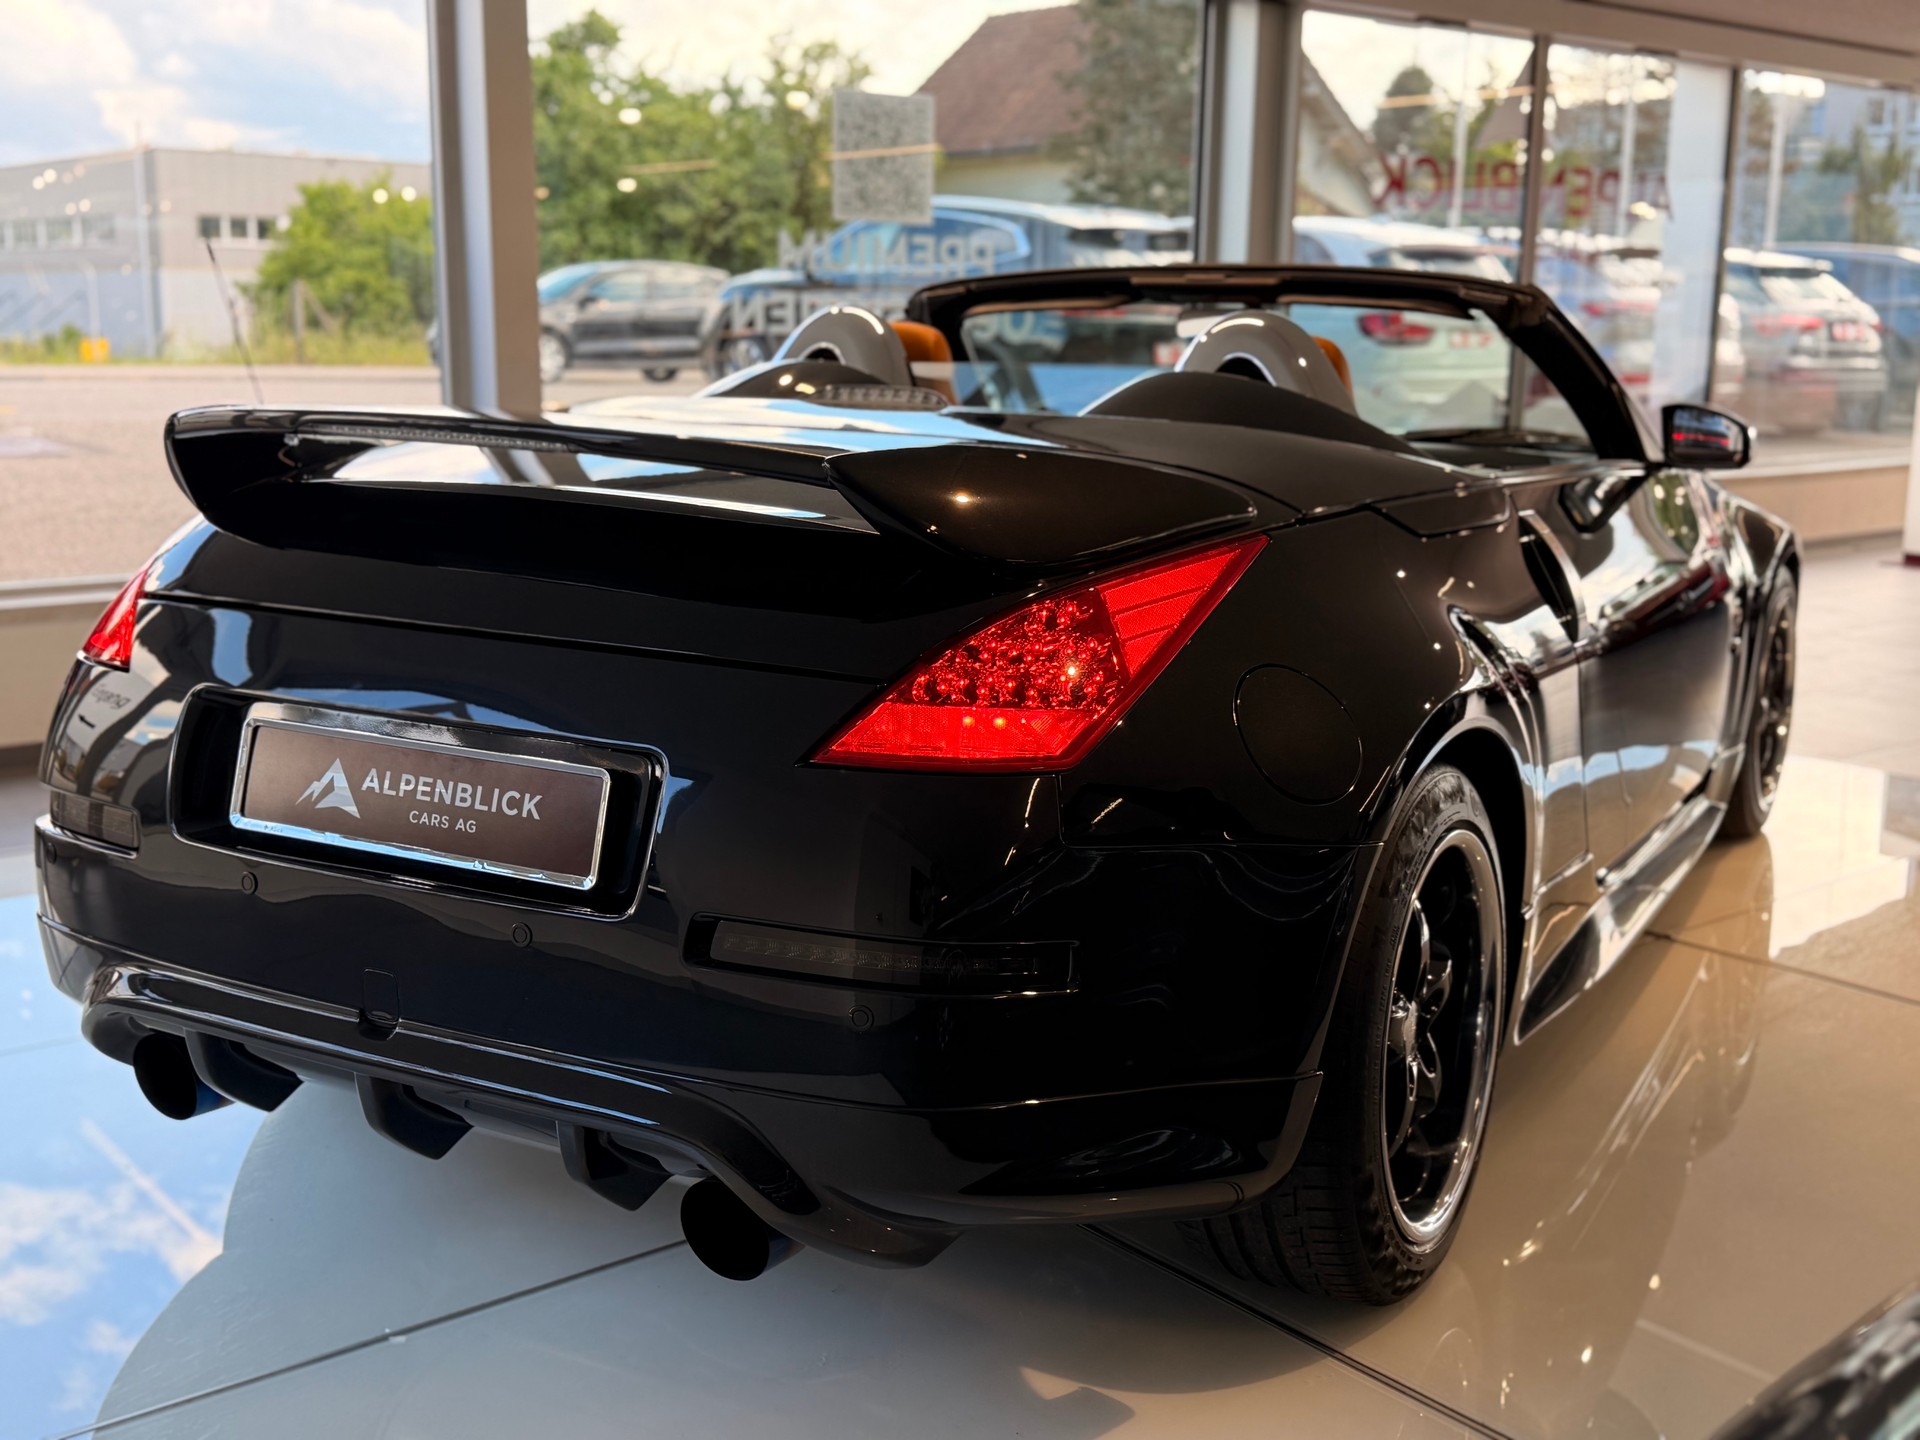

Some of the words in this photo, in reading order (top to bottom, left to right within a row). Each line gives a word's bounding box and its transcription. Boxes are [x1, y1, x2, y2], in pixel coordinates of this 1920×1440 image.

[361, 768, 543, 820] ALPENBLICK
[409, 810, 450, 829] CARS
[455, 818, 477, 833] AG
